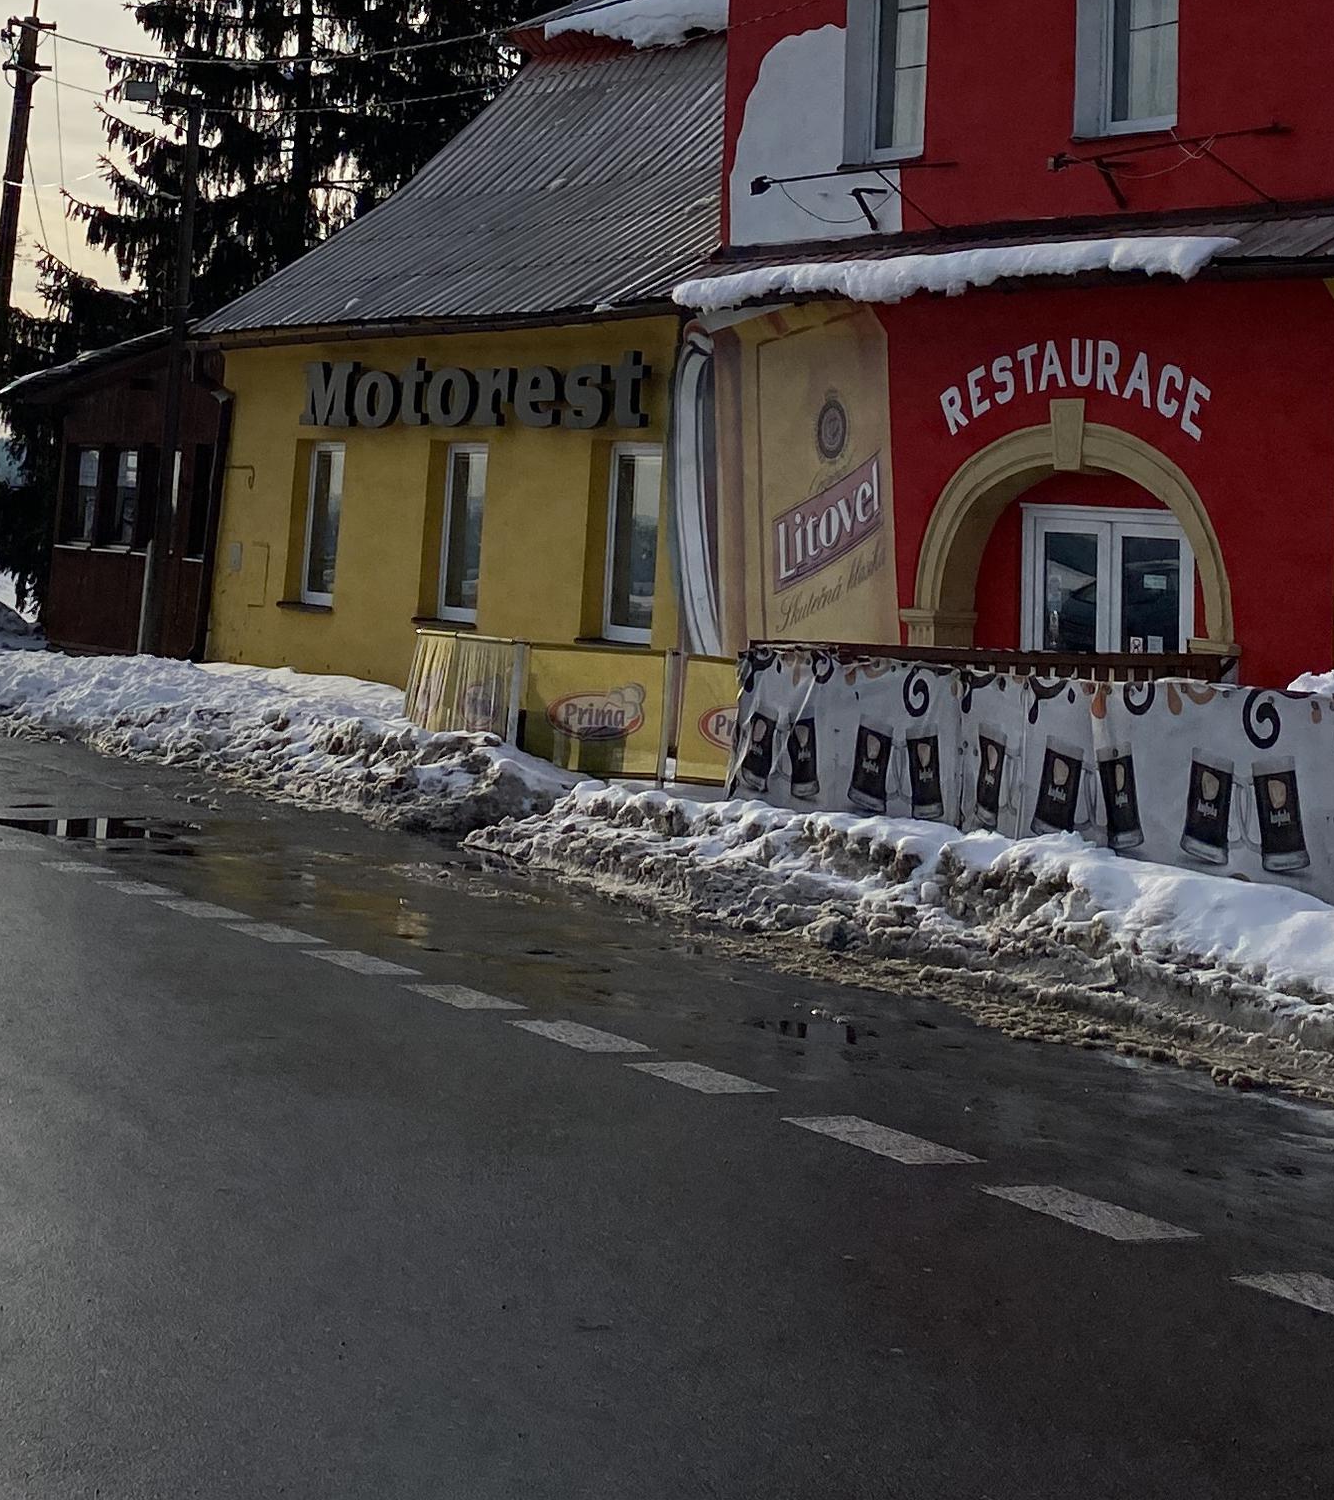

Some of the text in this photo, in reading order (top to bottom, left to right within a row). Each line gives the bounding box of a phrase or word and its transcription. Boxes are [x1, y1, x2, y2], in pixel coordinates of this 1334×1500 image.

[299, 350, 653, 429] Motorest
[939, 337, 1213, 442] RESTAURACE
[777, 459, 881, 581] Litovel
[563, 701, 626, 729] Prima
[715, 714, 736, 737] Pr
